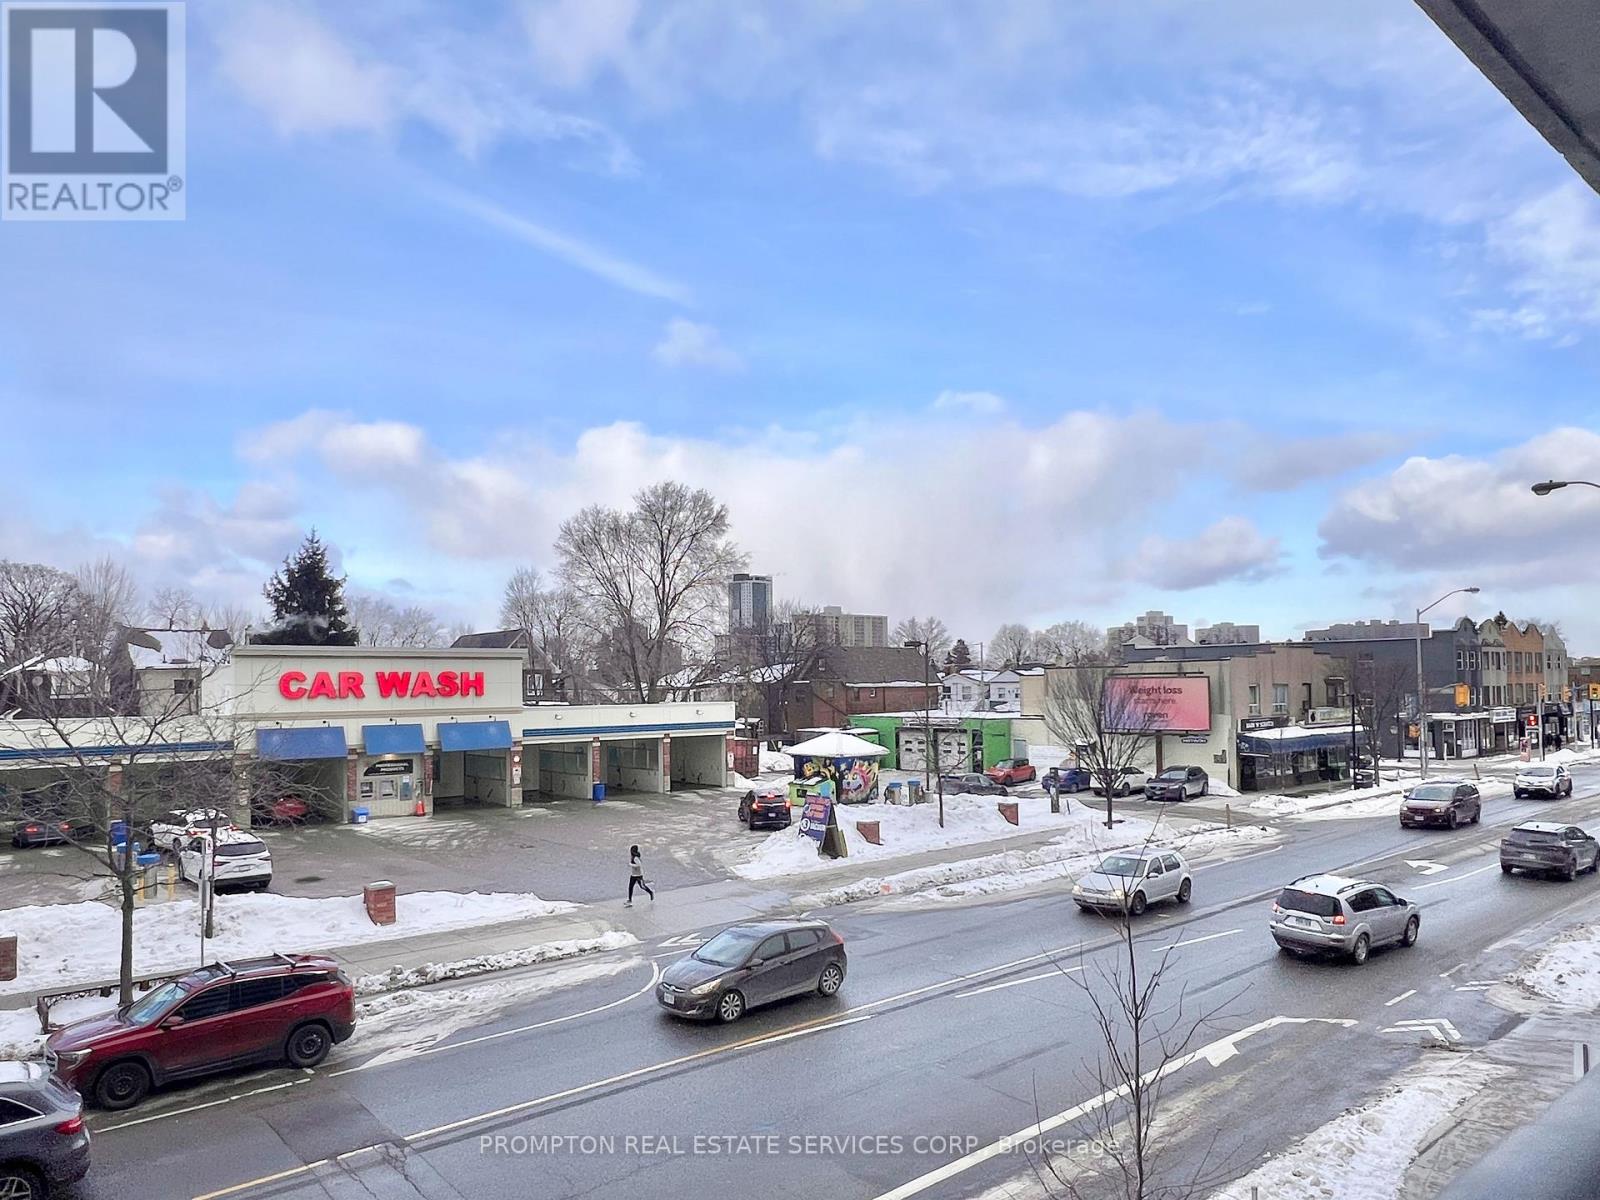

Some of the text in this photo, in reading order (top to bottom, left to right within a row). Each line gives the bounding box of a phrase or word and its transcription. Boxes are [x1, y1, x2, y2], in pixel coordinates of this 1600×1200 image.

[278, 670, 485, 700] CAR WASH
[1129, 685, 1183, 696] Weight loss
